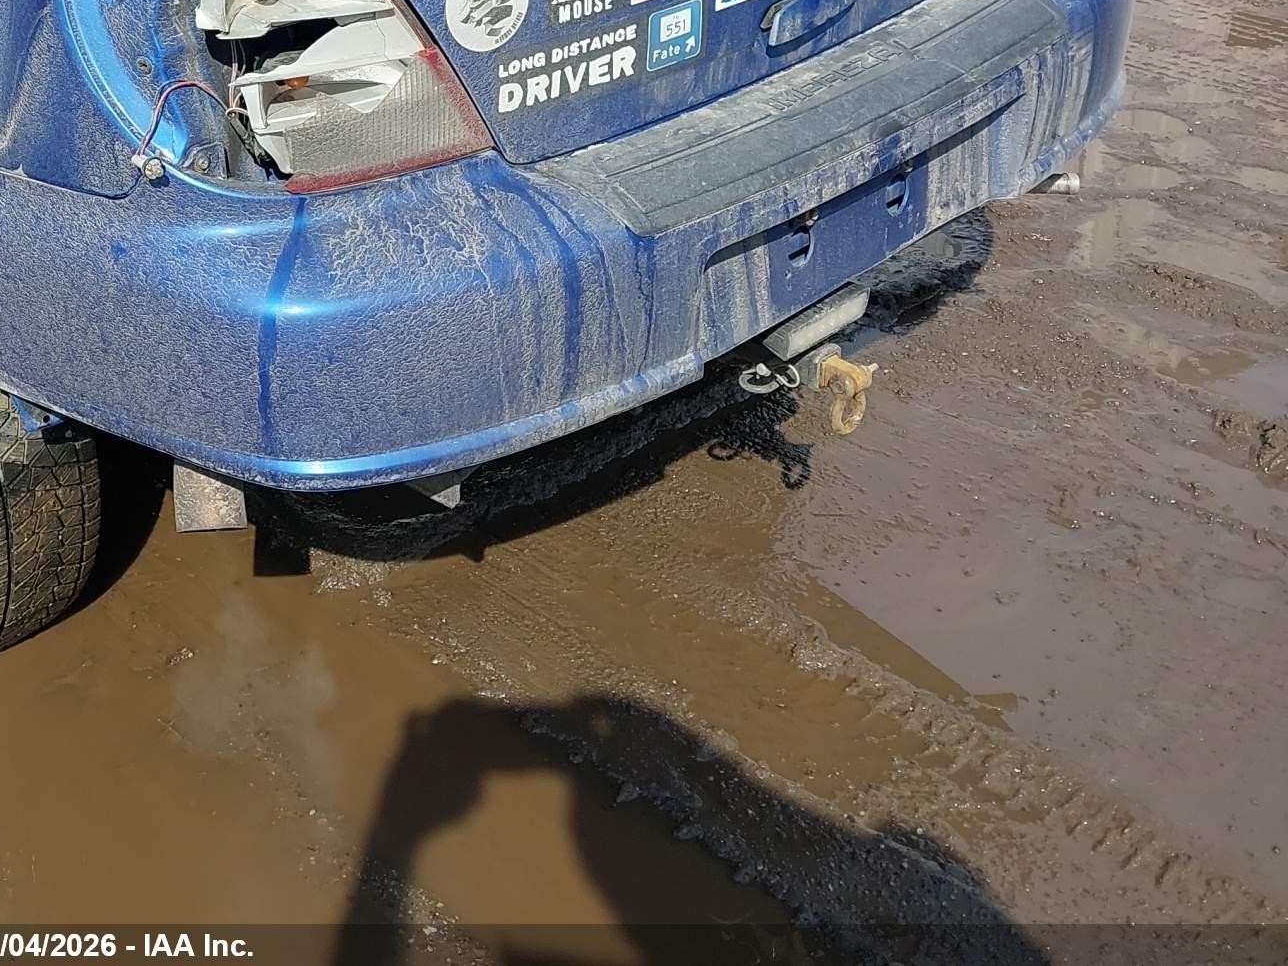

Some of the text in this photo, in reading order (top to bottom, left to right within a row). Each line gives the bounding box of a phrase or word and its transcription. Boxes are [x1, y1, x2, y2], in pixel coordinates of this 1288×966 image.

[665, 18, 686, 38] 551
[498, 51, 546, 78] LONG
[551, 23, 637, 64] DISTANCE
[652, 44, 681, 63] Fate
[497, 45, 637, 114] DRIVER
